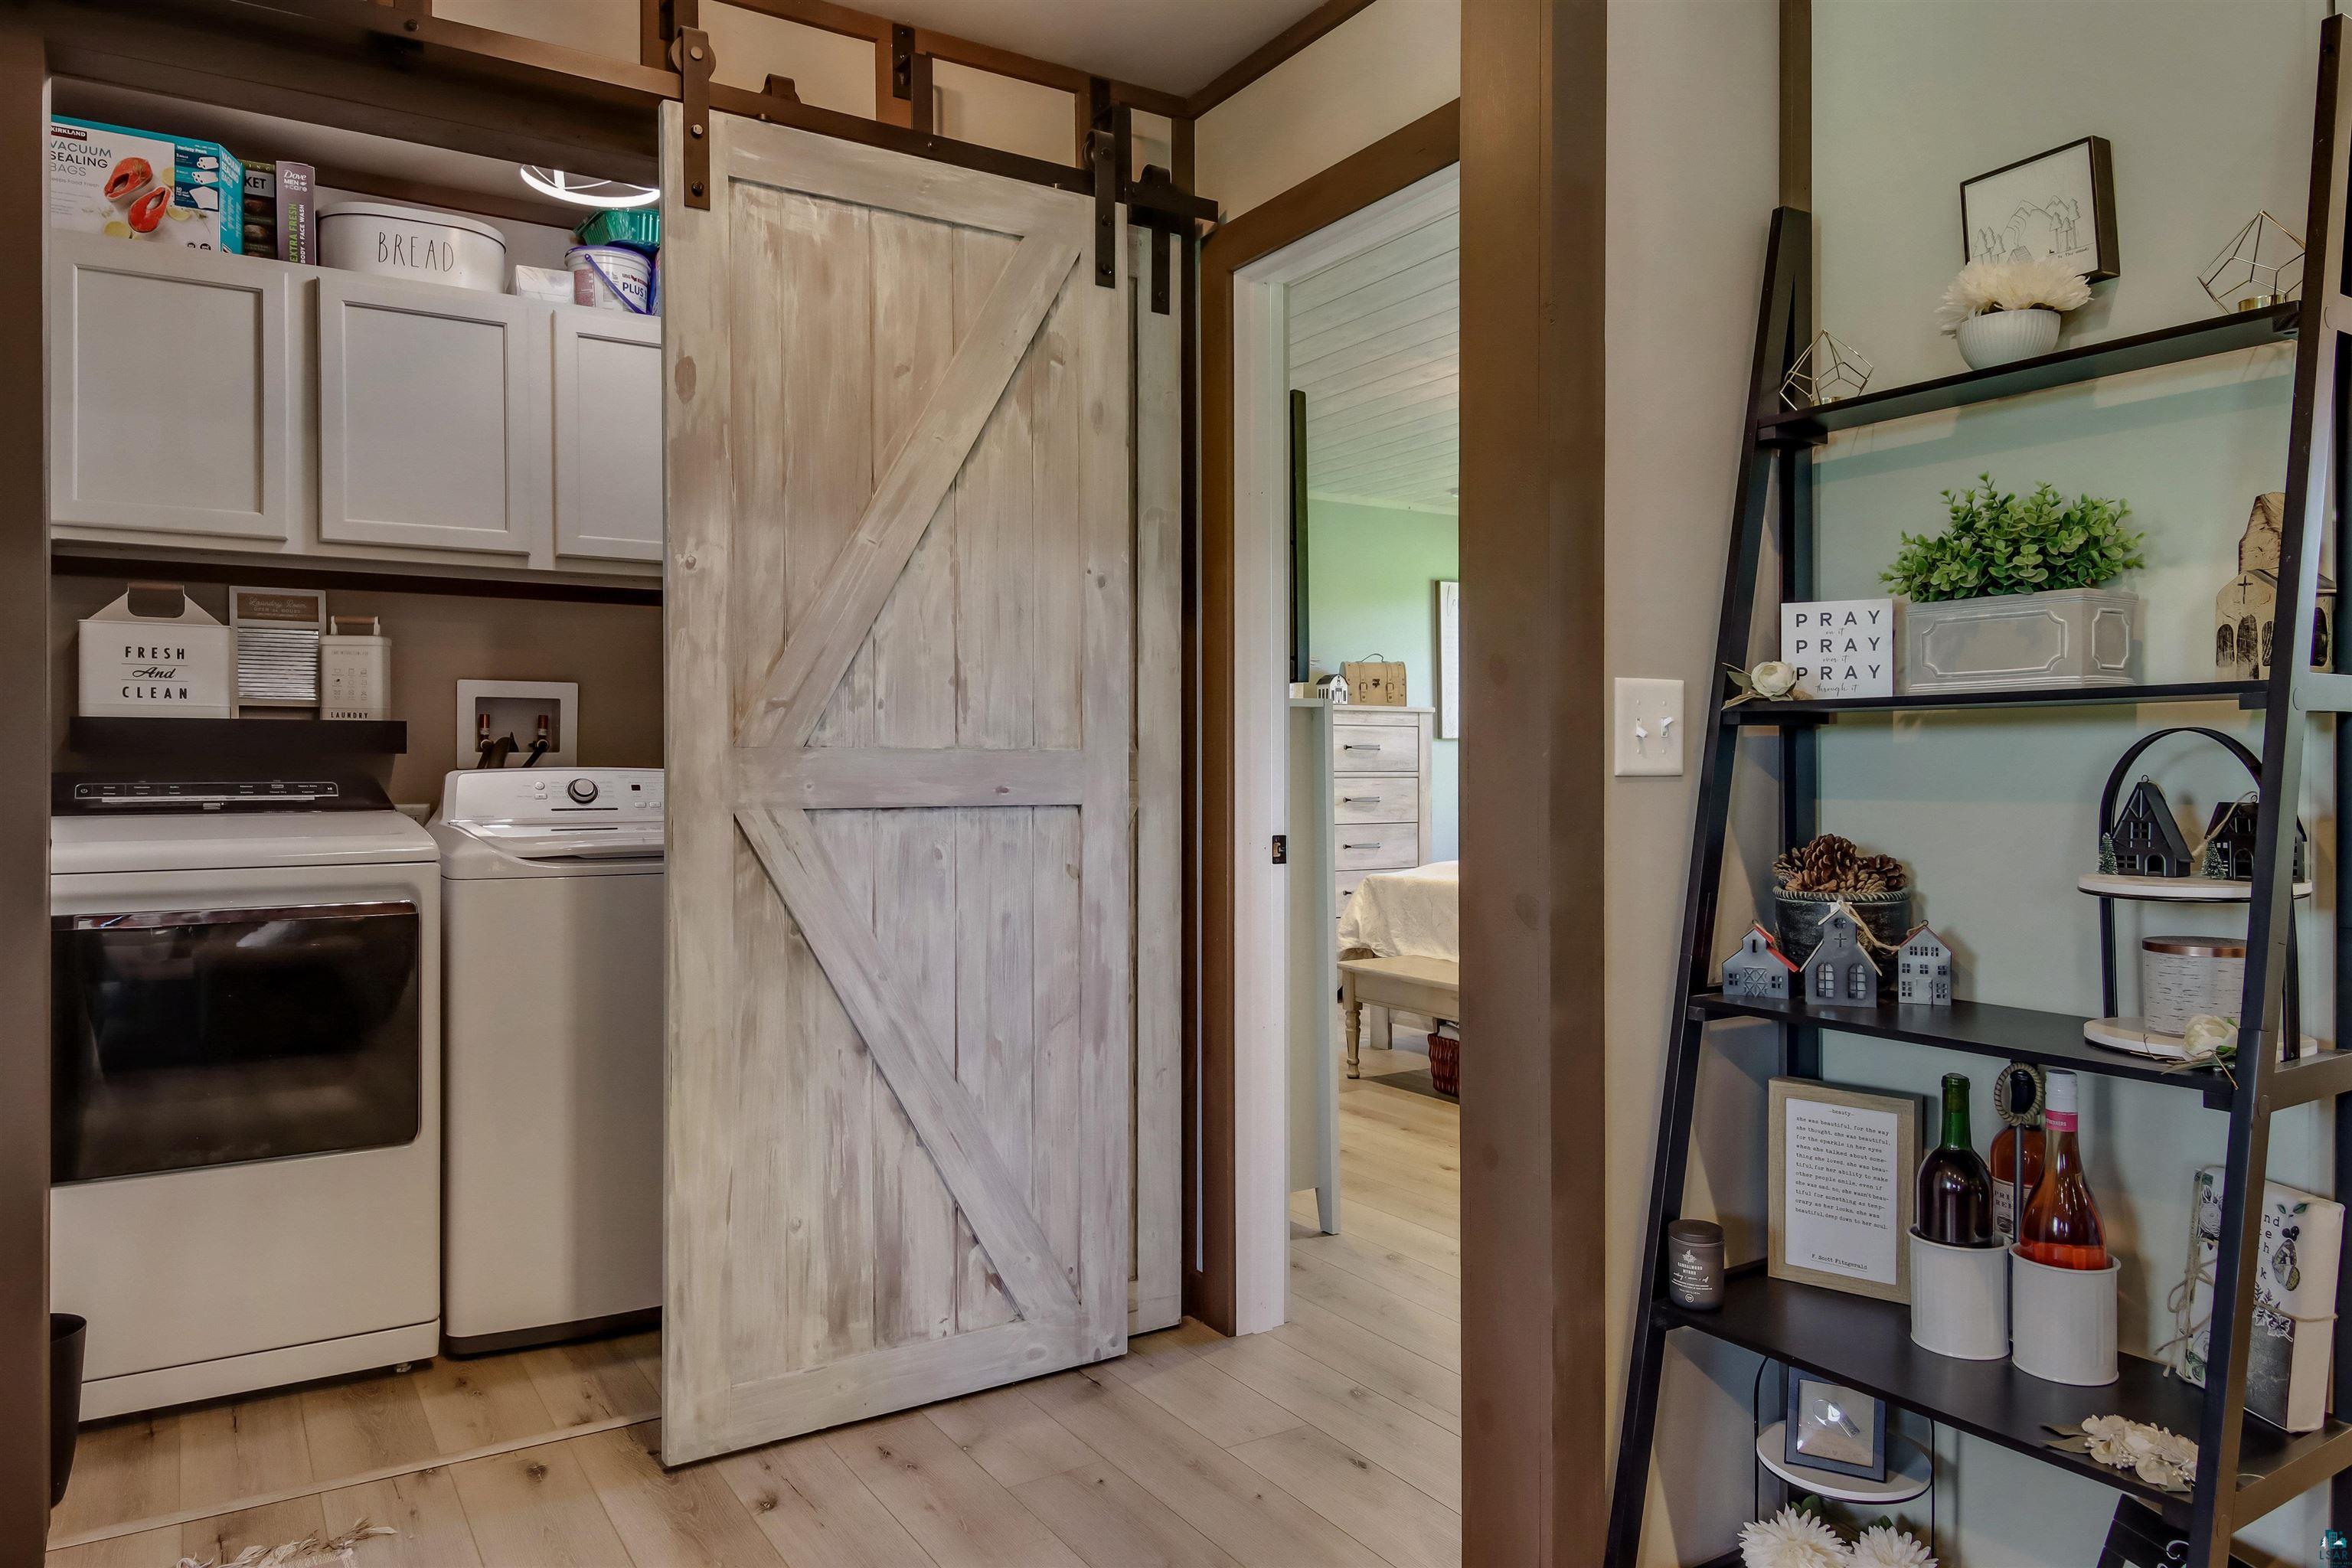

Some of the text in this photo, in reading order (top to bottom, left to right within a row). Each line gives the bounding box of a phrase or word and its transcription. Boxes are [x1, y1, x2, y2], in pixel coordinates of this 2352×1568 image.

[51, 126, 86, 137] KIRKLAND
[51, 140, 112, 158] VACUUM
[51, 150, 108, 168] SEALING
[51, 162, 87, 177] BAGS
[284, 169, 307, 181] Dove
[288, 203, 298, 263] EXTRA FRESH
[377, 231, 455, 273] BREAD
[622, 282, 644, 297] PLUS
[1795, 610, 1880, 628] PRAY
[1838, 627, 1847, 636] it
[125, 645, 185, 660] FRESH
[1795, 636, 1880, 654] PRAY
[1841, 655, 1850, 664] it
[132, 666, 176, 679] And
[1796, 665, 1880, 681] PRAY
[122, 686, 188, 700] CLEAN
[1815, 682, 1860, 697] through it
[1834, 1258, 1867, 1270] Fitzgerald
